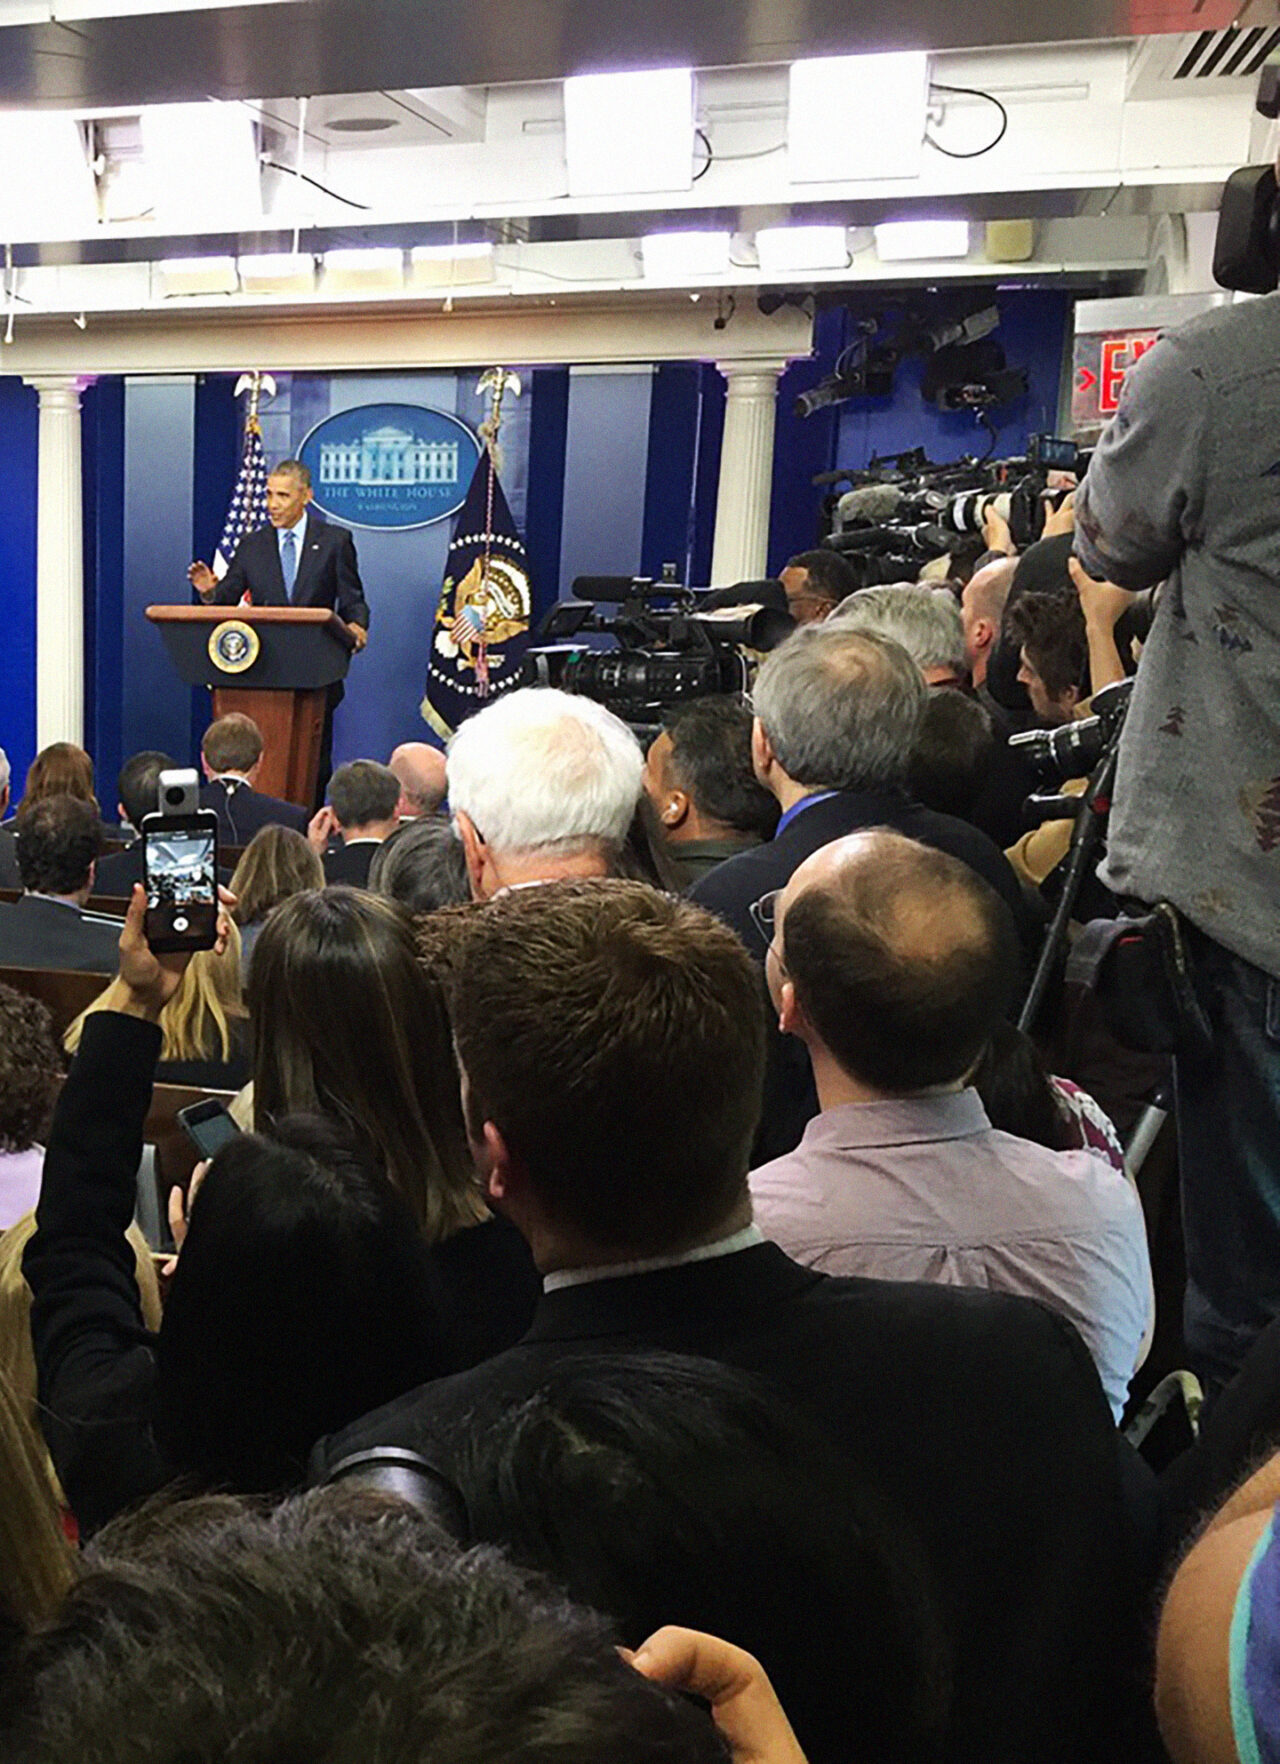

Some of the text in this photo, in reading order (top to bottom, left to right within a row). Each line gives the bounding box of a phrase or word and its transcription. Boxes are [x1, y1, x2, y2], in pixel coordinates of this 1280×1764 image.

[1099, 340, 1156, 411] E
[324, 486, 451, 498] THE WHITE HOUSE
